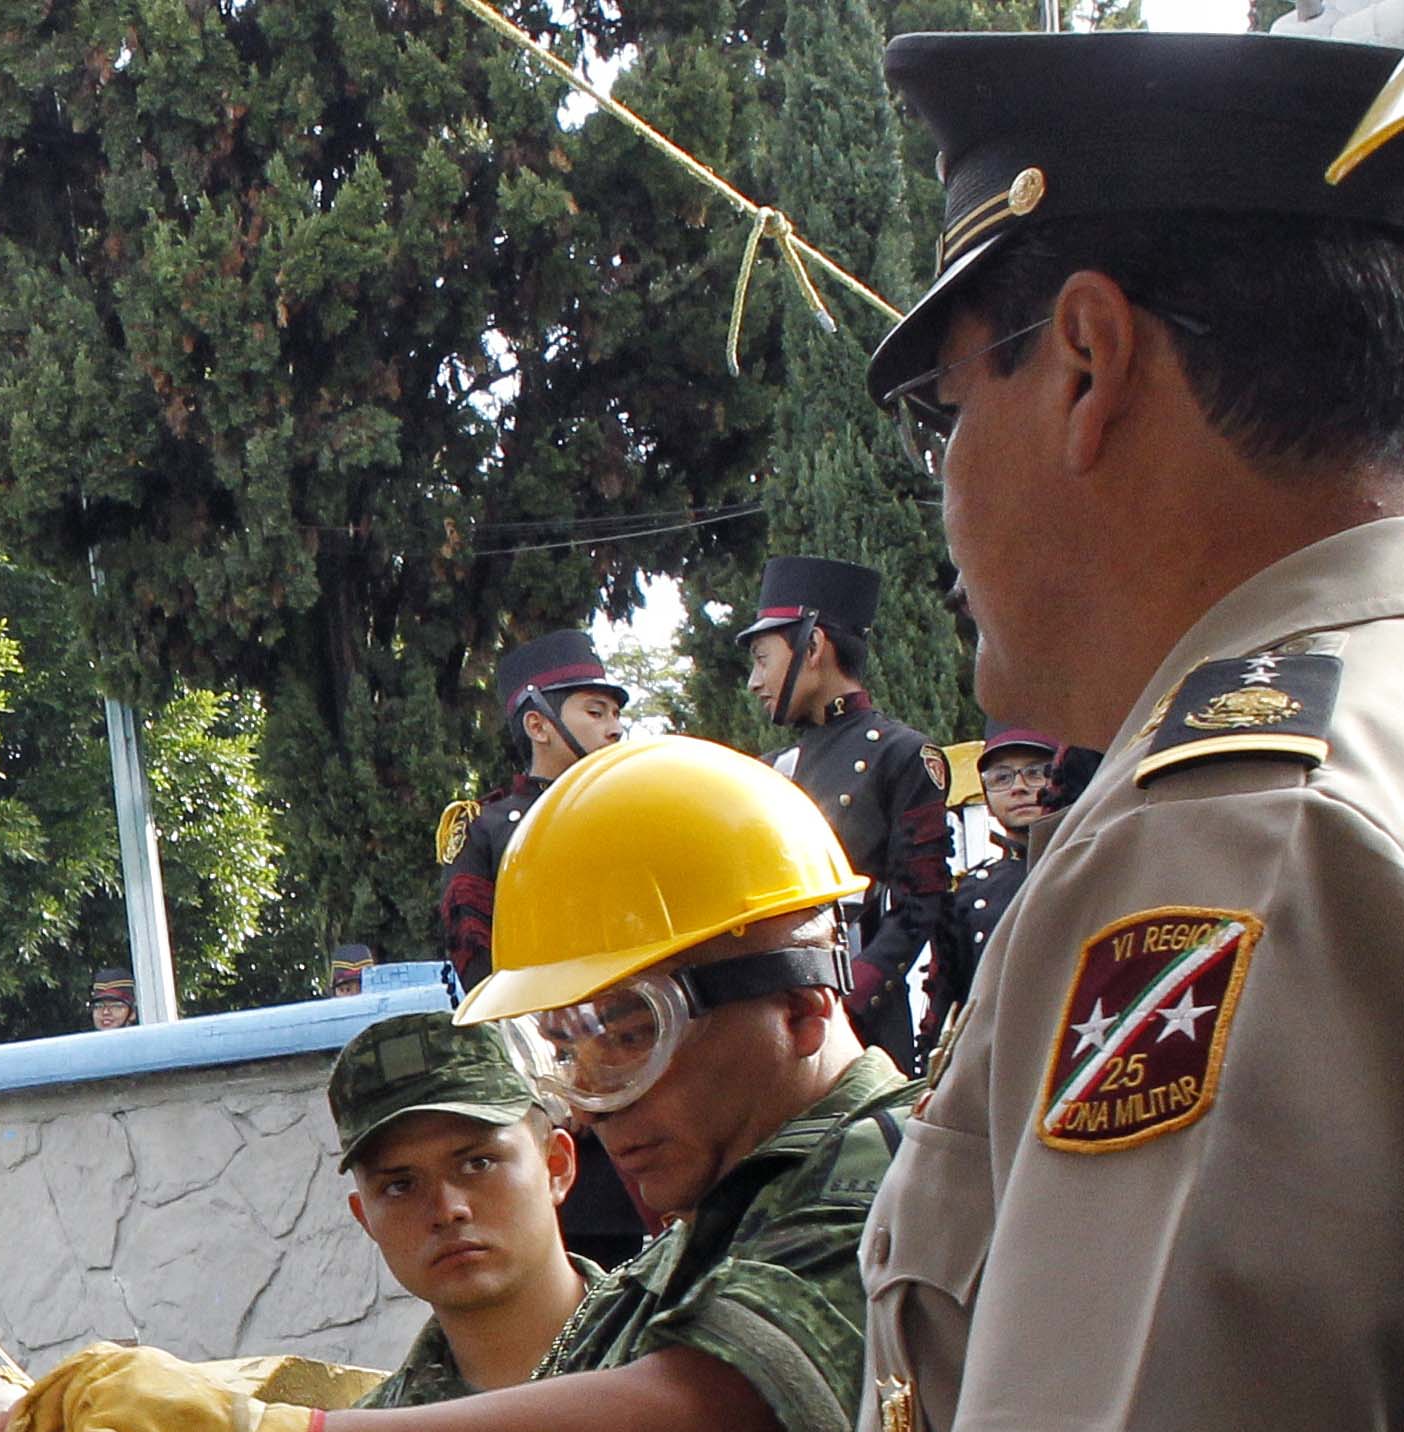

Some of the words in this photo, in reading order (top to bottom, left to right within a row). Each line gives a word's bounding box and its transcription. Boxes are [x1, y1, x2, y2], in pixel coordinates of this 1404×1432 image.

[1112, 932, 1135, 962] VI
[1099, 1053, 1148, 1093] 25
[1114, 1075, 1201, 1127] MILITAR
